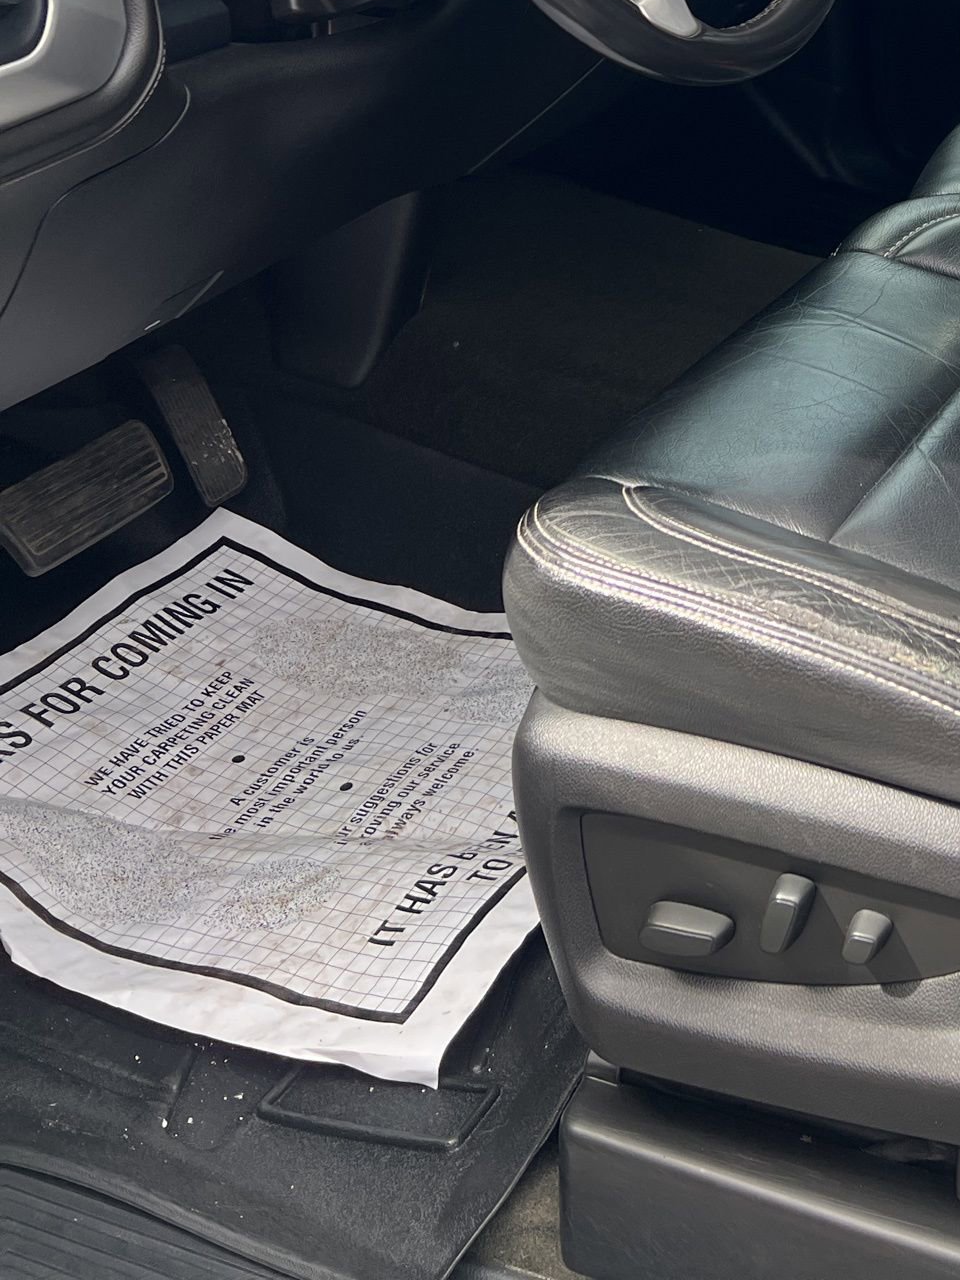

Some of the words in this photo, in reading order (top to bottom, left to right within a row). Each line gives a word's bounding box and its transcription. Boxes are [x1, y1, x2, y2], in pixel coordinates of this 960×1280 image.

[19, 676, 106, 729] FOR
[91, 593, 222, 681] COMING
[205, 568, 255, 600] IN
[84, 766, 113, 788] WE
[109, 737, 150, 768] HAVE
[143, 712, 186, 743] TRIED
[181, 698, 205, 713] TO
[201, 671, 234, 698] KEEP
[102, 765, 146, 797] YOUR
[142, 710, 216, 766] CARPETING
[212, 677, 255, 711] CLEAN
[127, 770, 169, 800] WITH
[163, 743, 200, 772] THIS
[196, 712, 241, 746] PAPER
[235, 689, 266, 714] MAT
[234, 797, 270, 826] most
[265, 745, 328, 798] important
[325, 709, 368, 746] person
[397, 779, 421, 799] our
[417, 742, 461, 779] service
[229, 797, 246, 807] A
[243, 747, 302, 796] customer
[296, 736, 316, 747] is
[253, 815, 274, 829] in
[269, 795, 296, 814] the
[293, 763, 330, 795] world
[326, 752, 344, 765] to
[350, 755, 421, 825] suggestions
[415, 742, 439, 759] for
[422, 748, 480, 797] welcome.
[367, 919, 406, 947] IT
[395, 863, 458, 915] HAS
[466, 858, 513, 881] TO
